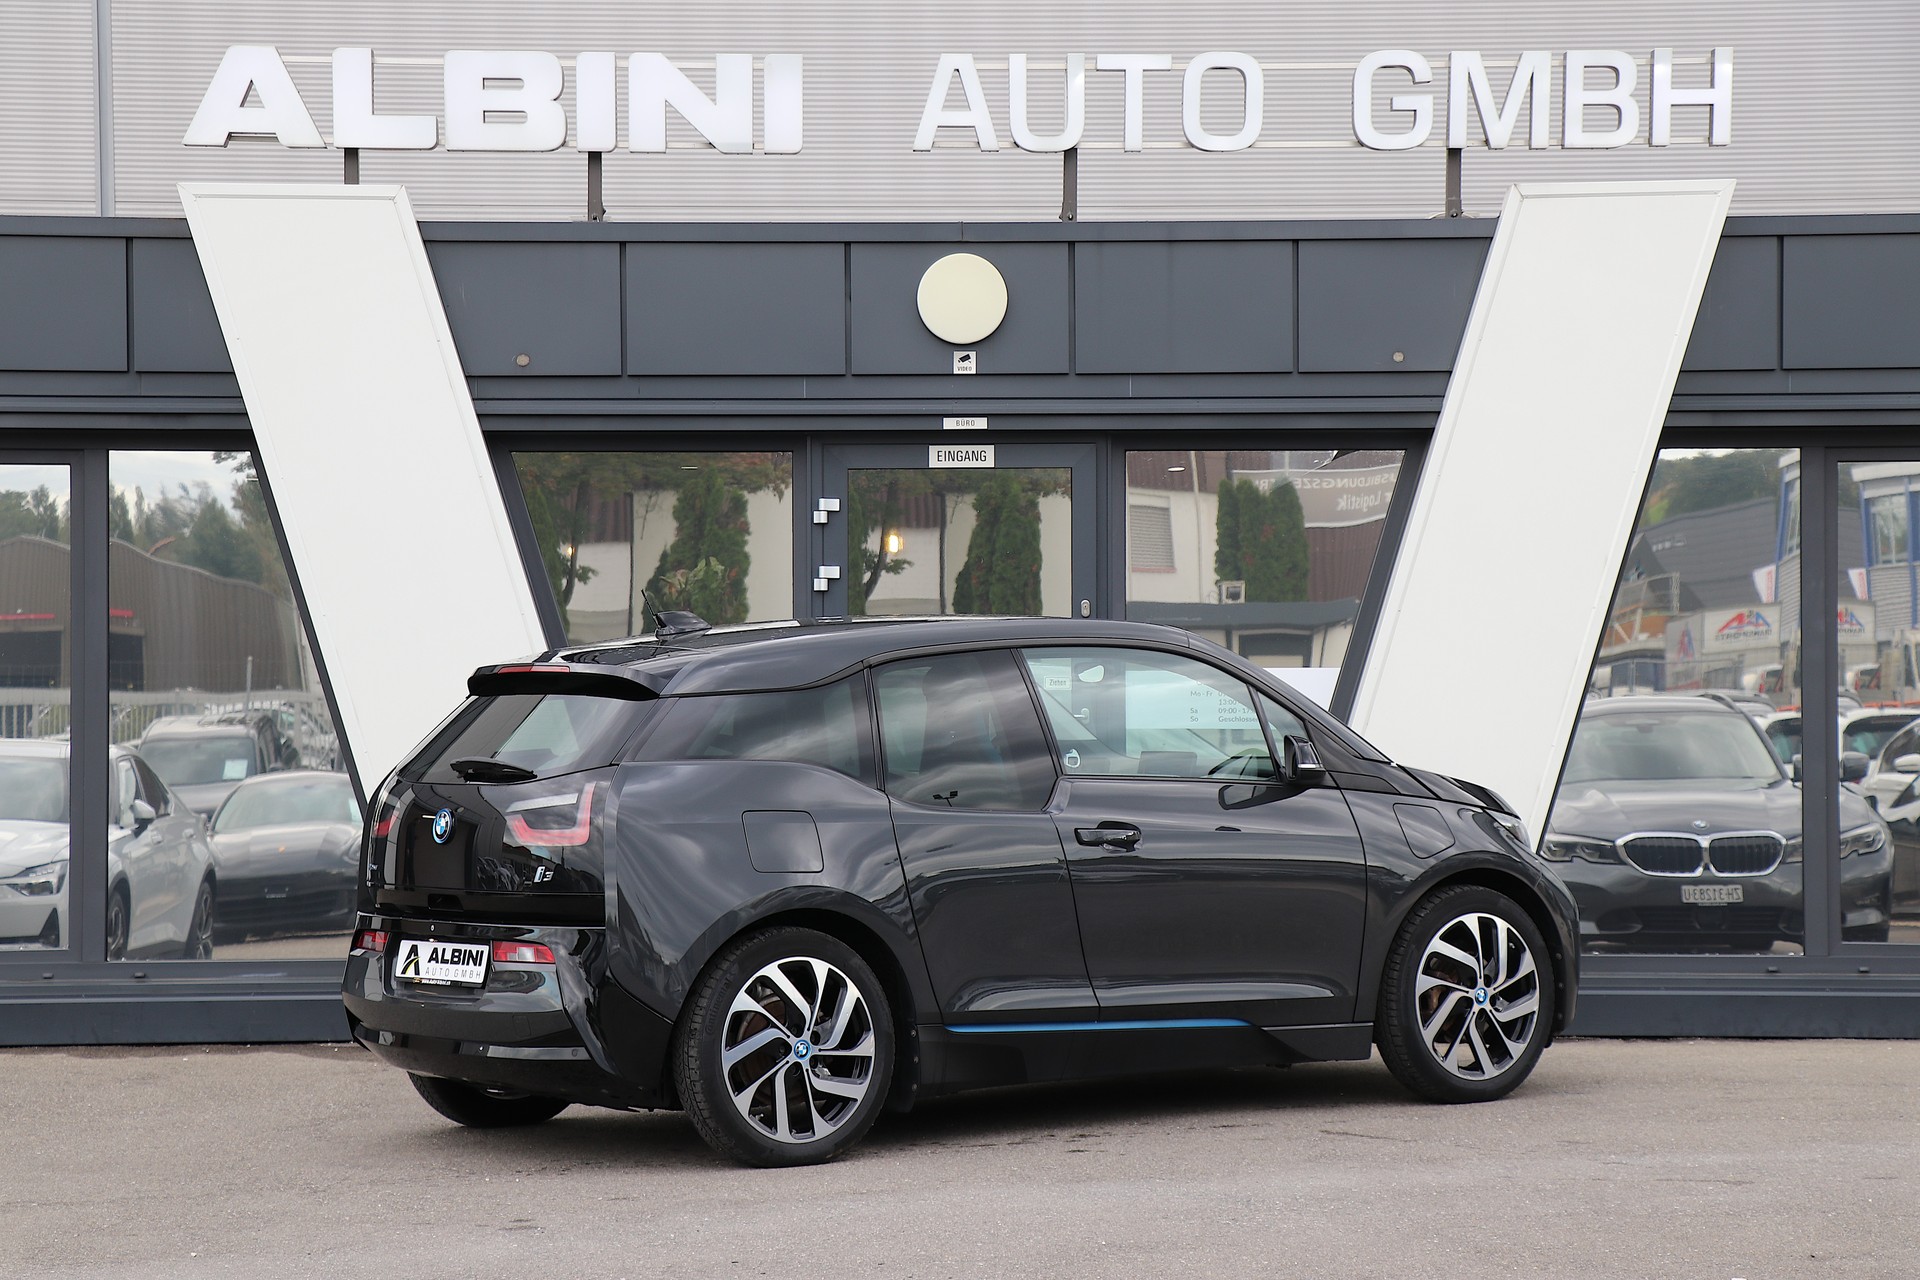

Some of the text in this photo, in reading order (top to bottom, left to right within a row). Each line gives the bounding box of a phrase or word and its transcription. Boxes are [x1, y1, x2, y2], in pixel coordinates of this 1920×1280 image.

[182, 44, 1734, 155] ALBINI AUTO GMBH
[955, 418, 976, 427] BÜRO
[937, 450, 987, 462] EINGANG
[1049, 678, 1067, 686] Ziehen
[533, 866, 554, 883] i3
[427, 947, 484, 966] ALBINI
[425, 967, 481, 979] AUTO GMBH
